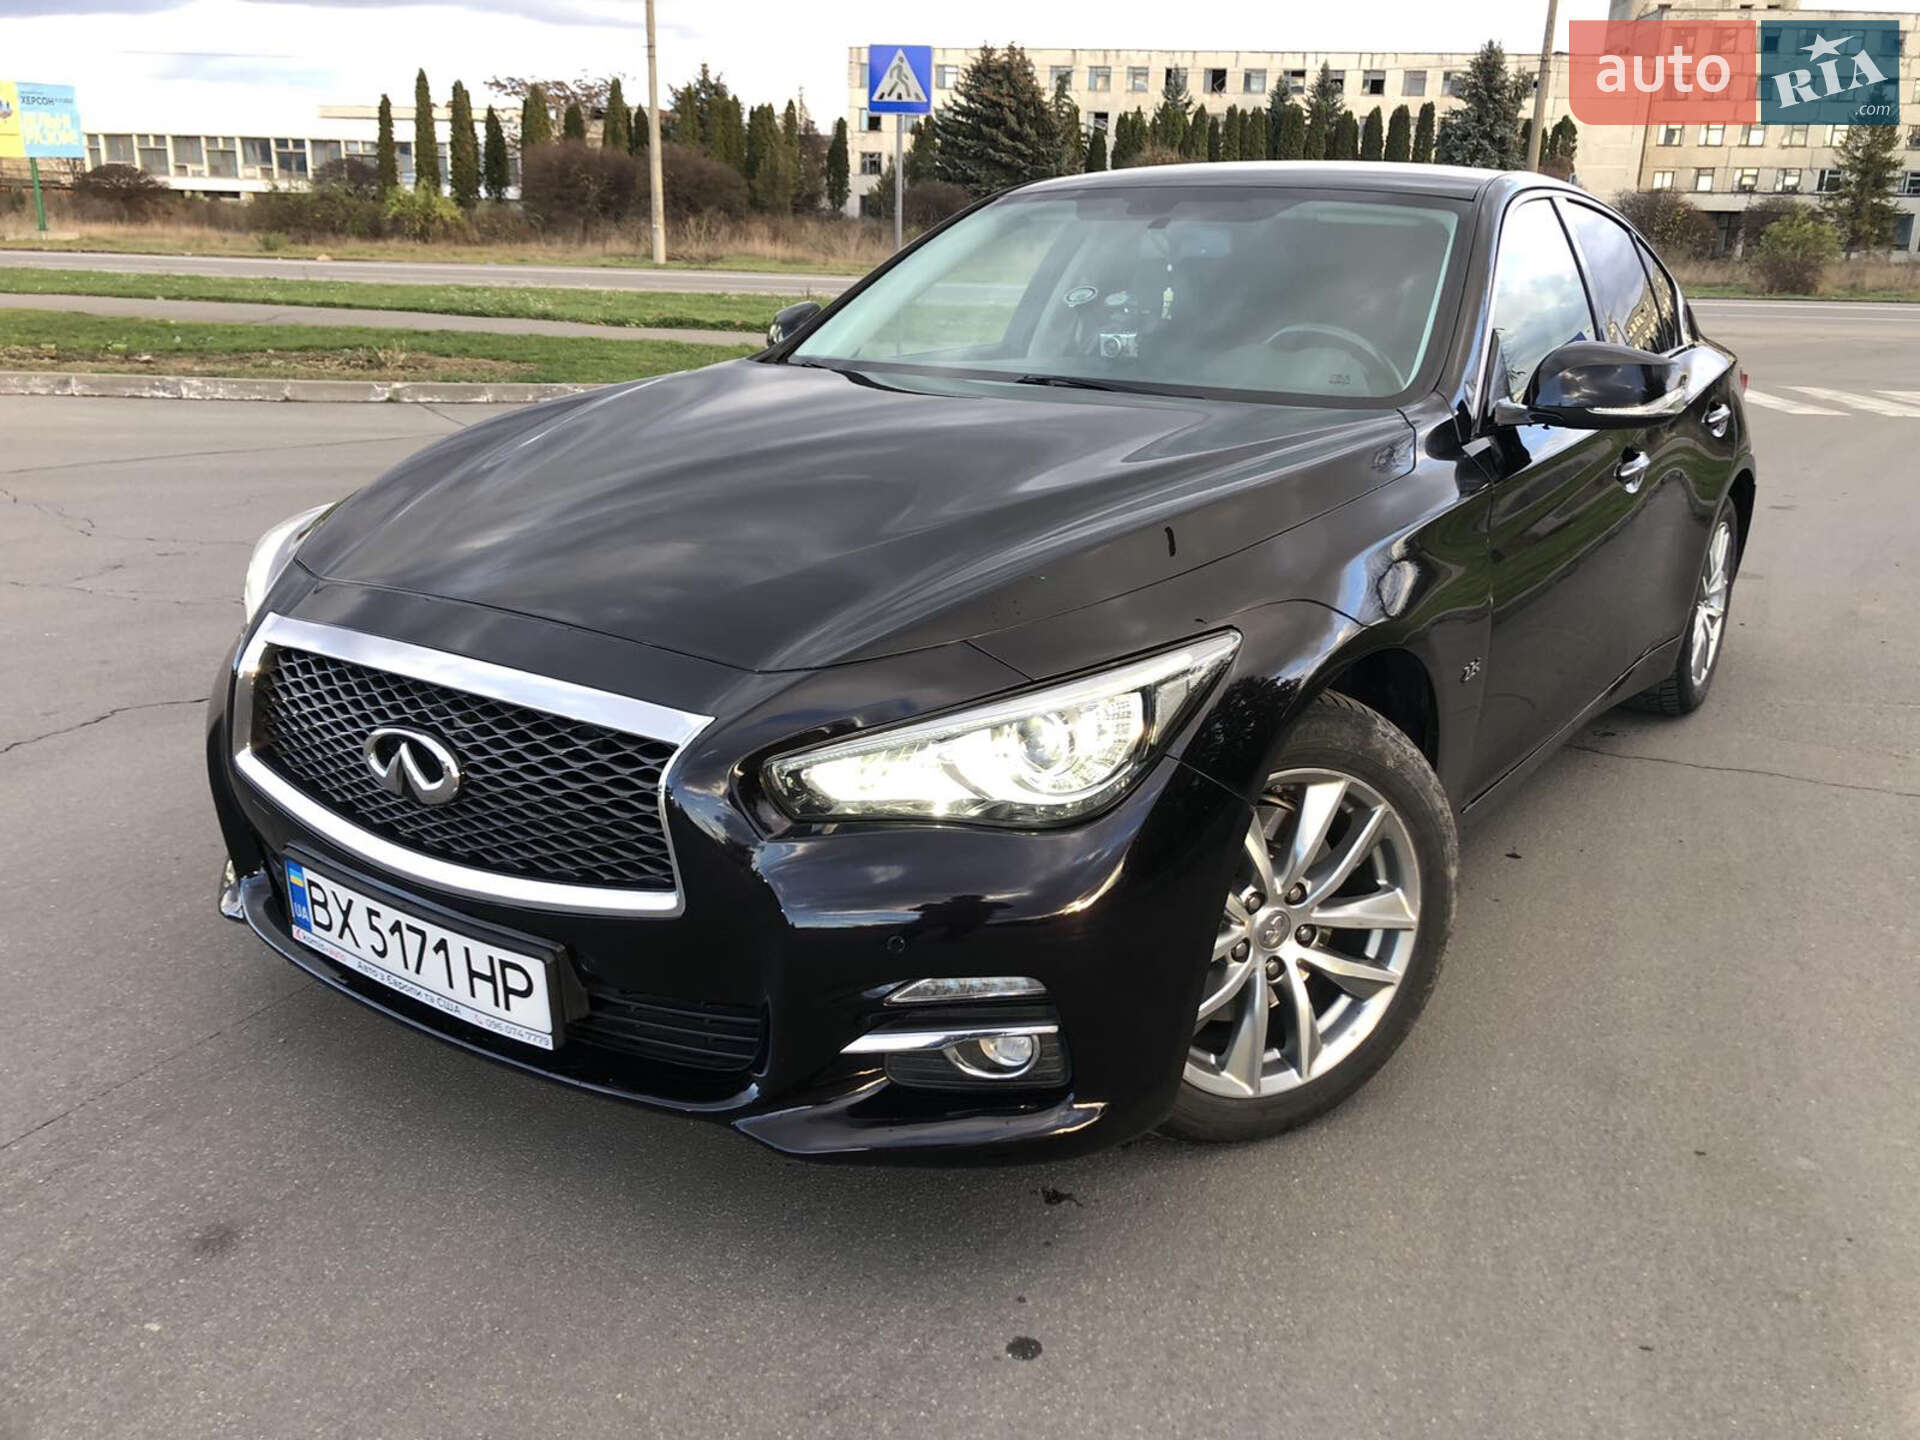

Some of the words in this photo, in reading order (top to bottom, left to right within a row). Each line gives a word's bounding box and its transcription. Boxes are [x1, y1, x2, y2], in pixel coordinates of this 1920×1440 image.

[21, 95, 55, 106] ХЕРСОН
[294, 901, 311, 920] UA
[306, 878, 361, 949] BX
[366, 906, 454, 990] 5171
[464, 946, 534, 1012] HP
[436, 997, 461, 1014] США
